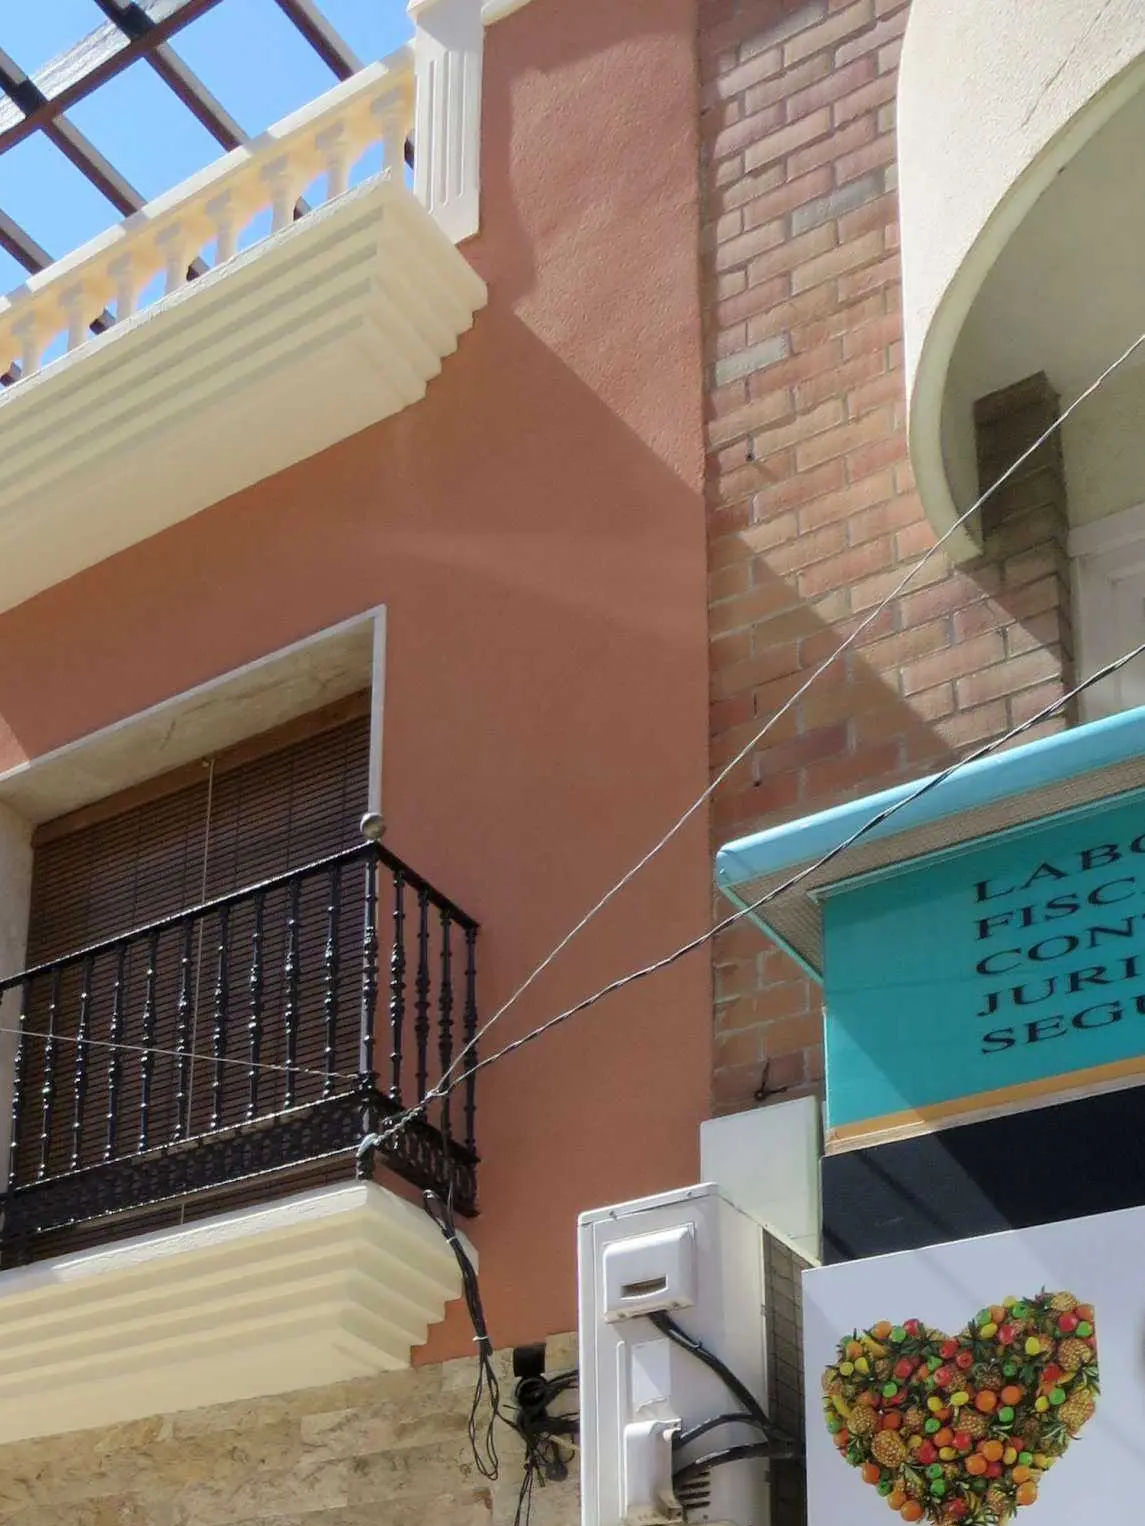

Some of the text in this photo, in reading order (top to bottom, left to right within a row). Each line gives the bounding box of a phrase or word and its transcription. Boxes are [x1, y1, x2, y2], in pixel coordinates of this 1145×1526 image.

[974, 832, 1145, 904] LAB
[973, 876, 1145, 941] FISC
[976, 912, 1145, 976] CON
[977, 954, 1142, 1017] JURI
